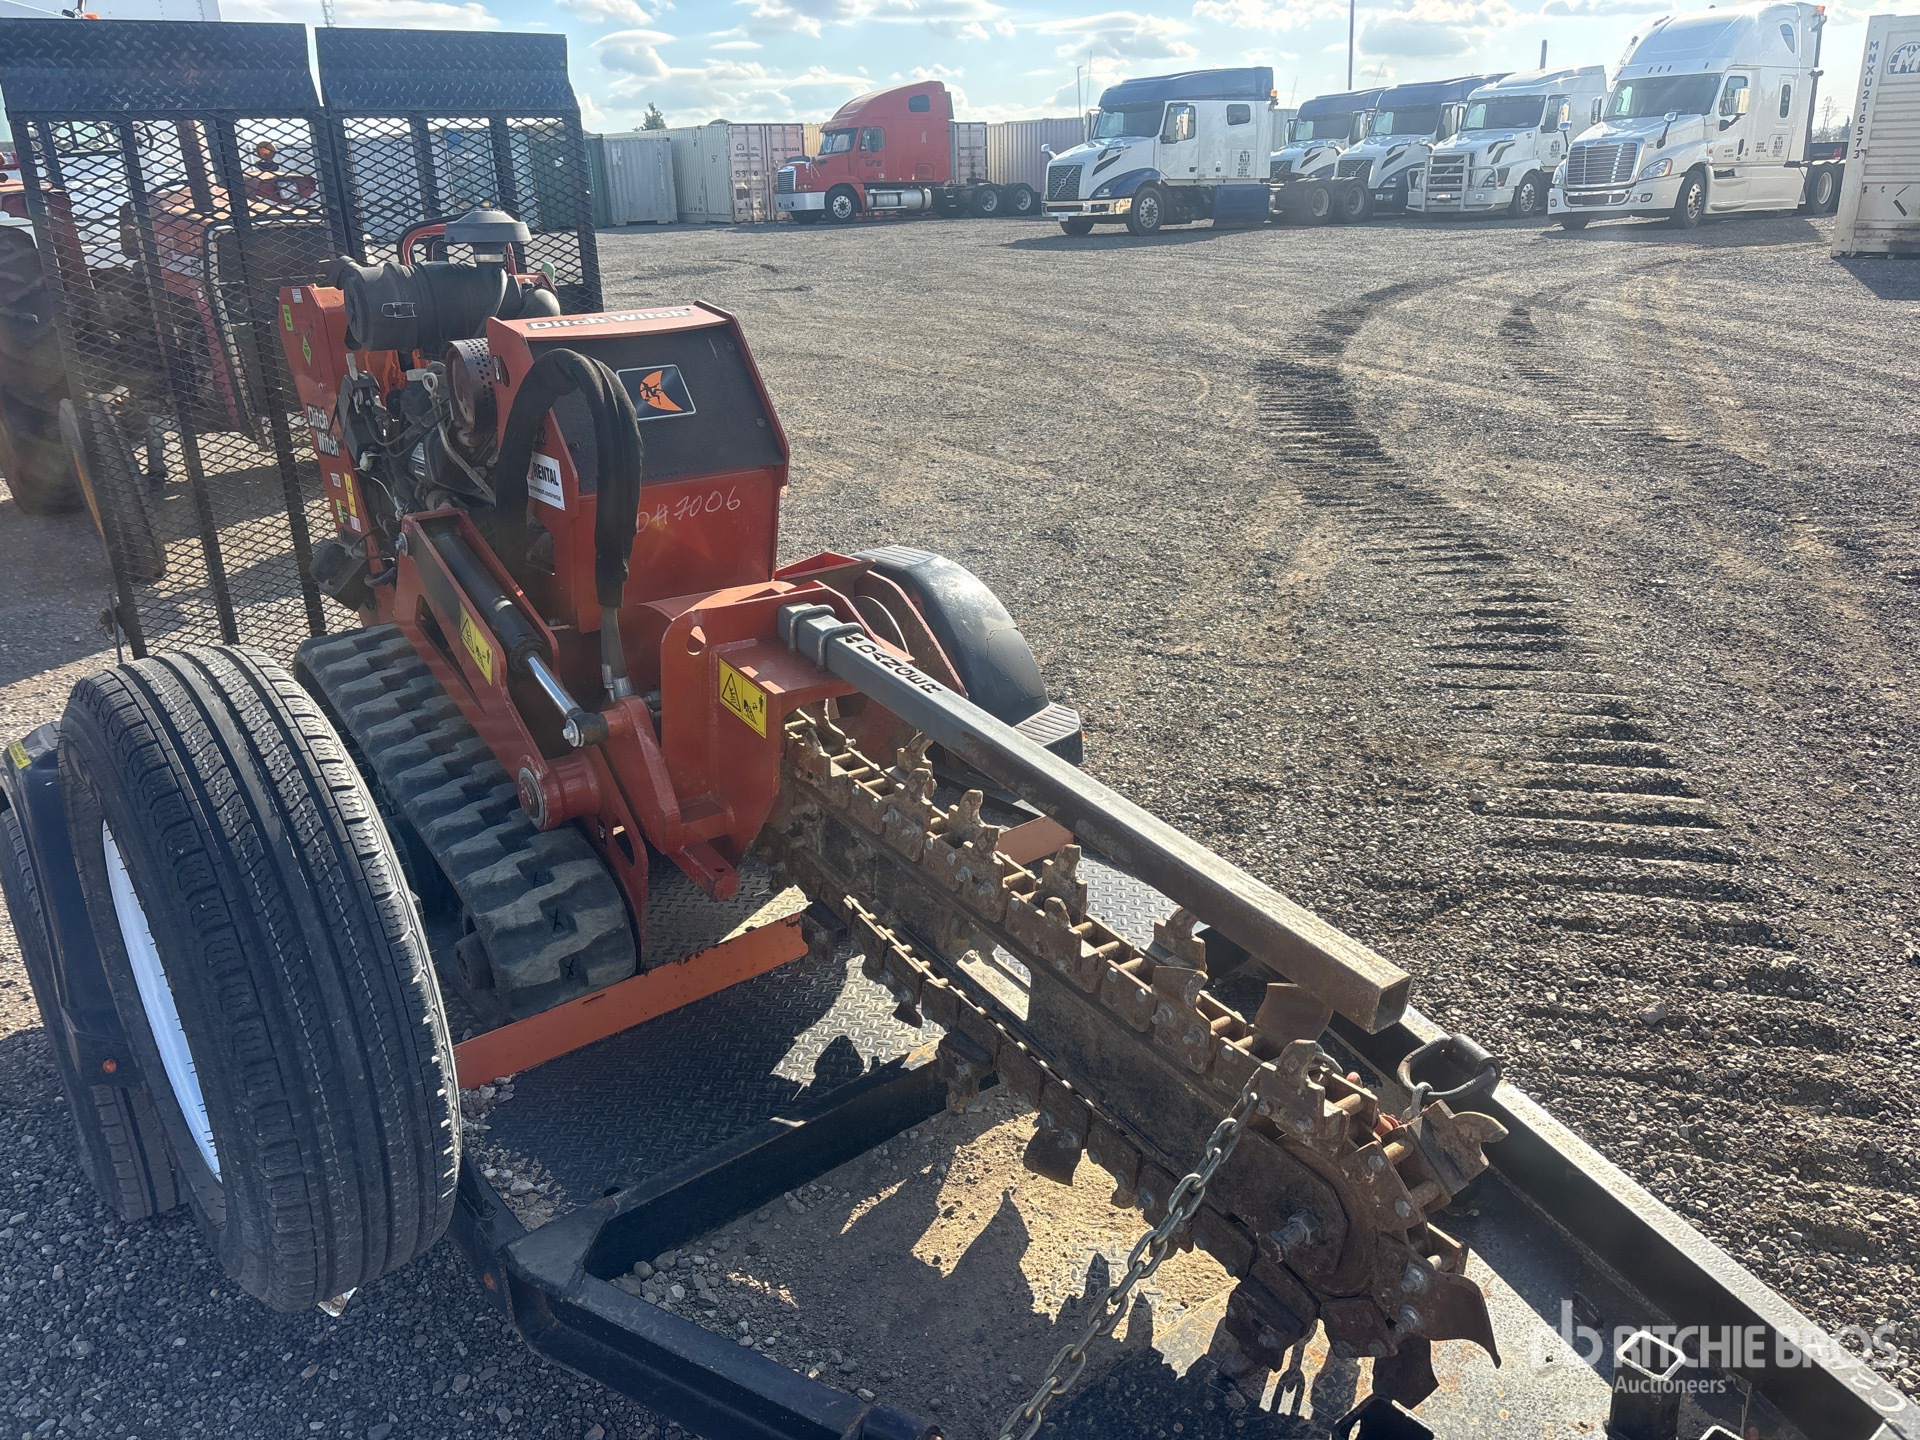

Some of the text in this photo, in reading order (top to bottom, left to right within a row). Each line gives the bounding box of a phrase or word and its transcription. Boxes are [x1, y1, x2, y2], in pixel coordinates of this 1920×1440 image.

[530, 310, 690, 330] Ditch Witch
[307, 405, 330, 431] Ditch
[316, 430, 340, 456] Witch
[532, 461, 560, 487] RENTAL
[856, 644, 943, 694] DANGER
